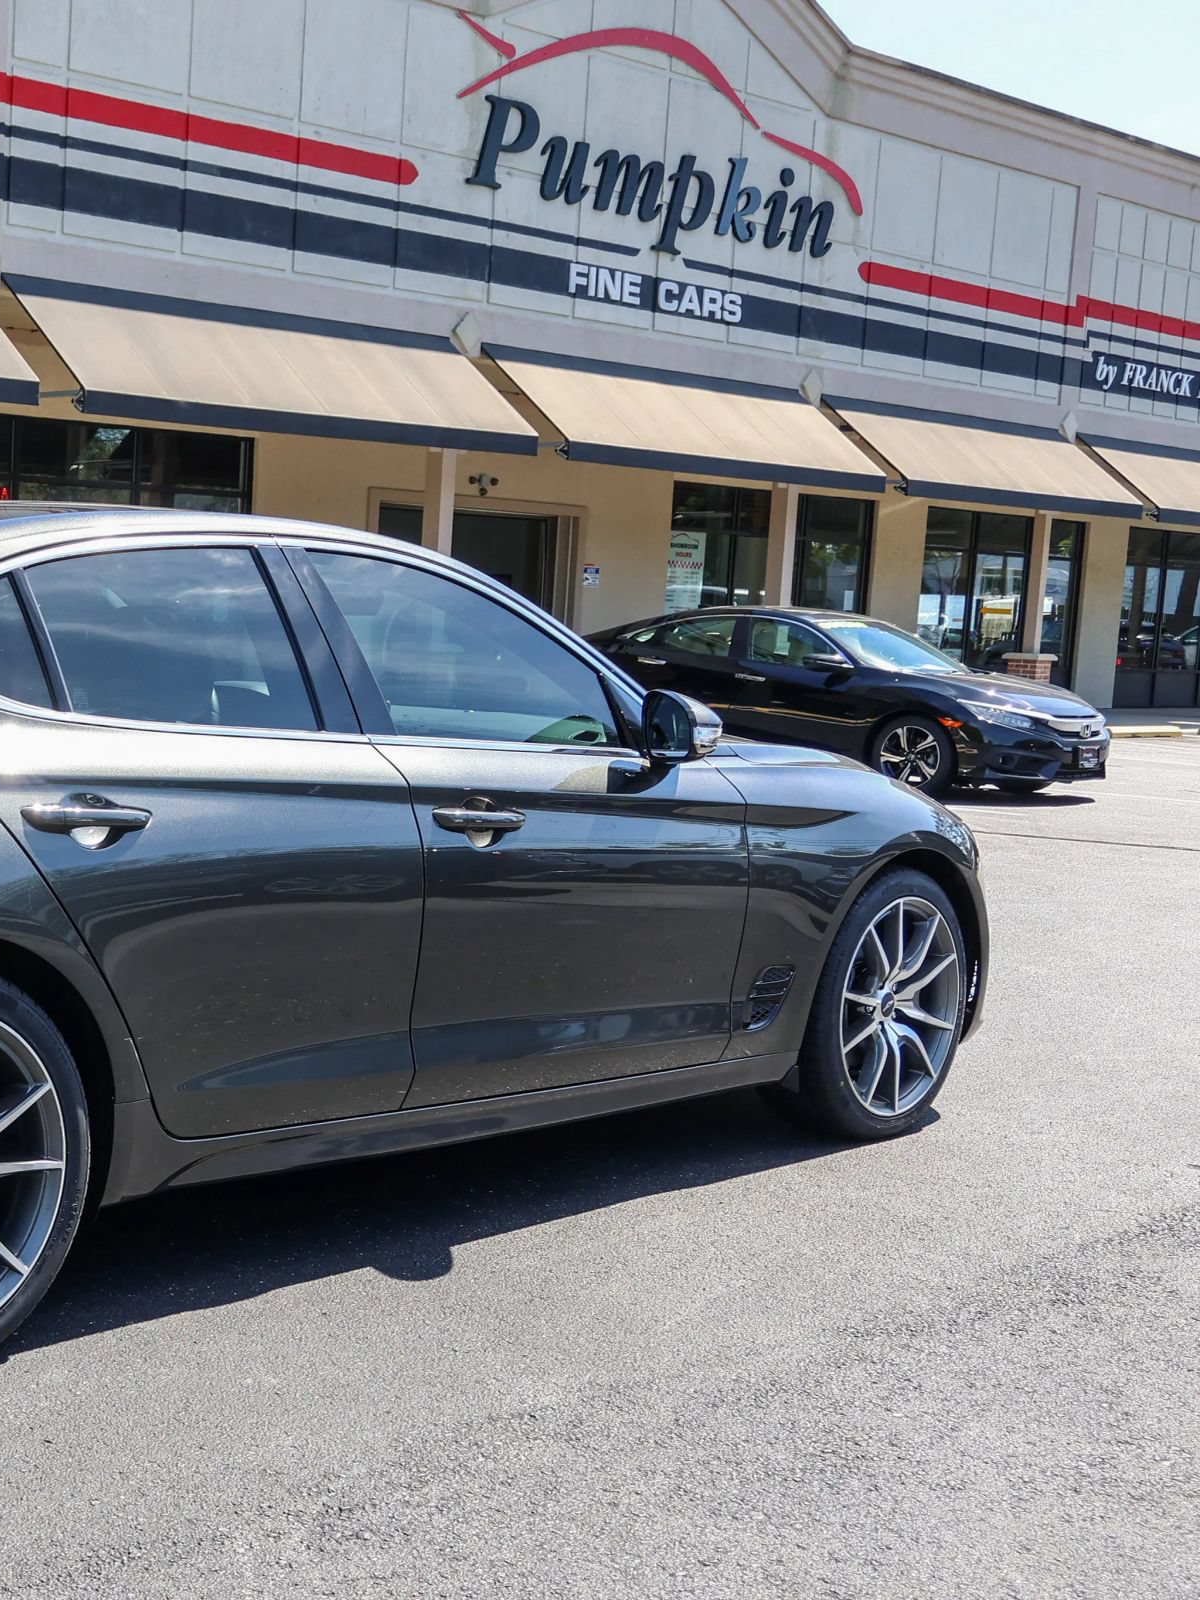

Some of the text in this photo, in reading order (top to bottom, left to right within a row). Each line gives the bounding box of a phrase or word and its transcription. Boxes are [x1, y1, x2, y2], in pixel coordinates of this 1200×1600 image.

[465, 94, 834, 259] Pumpkin
[567, 261, 743, 324] FINE CARS
[1095, 356, 1195, 398] by FRANCK
[670, 542, 699, 550] SHOWROOM
